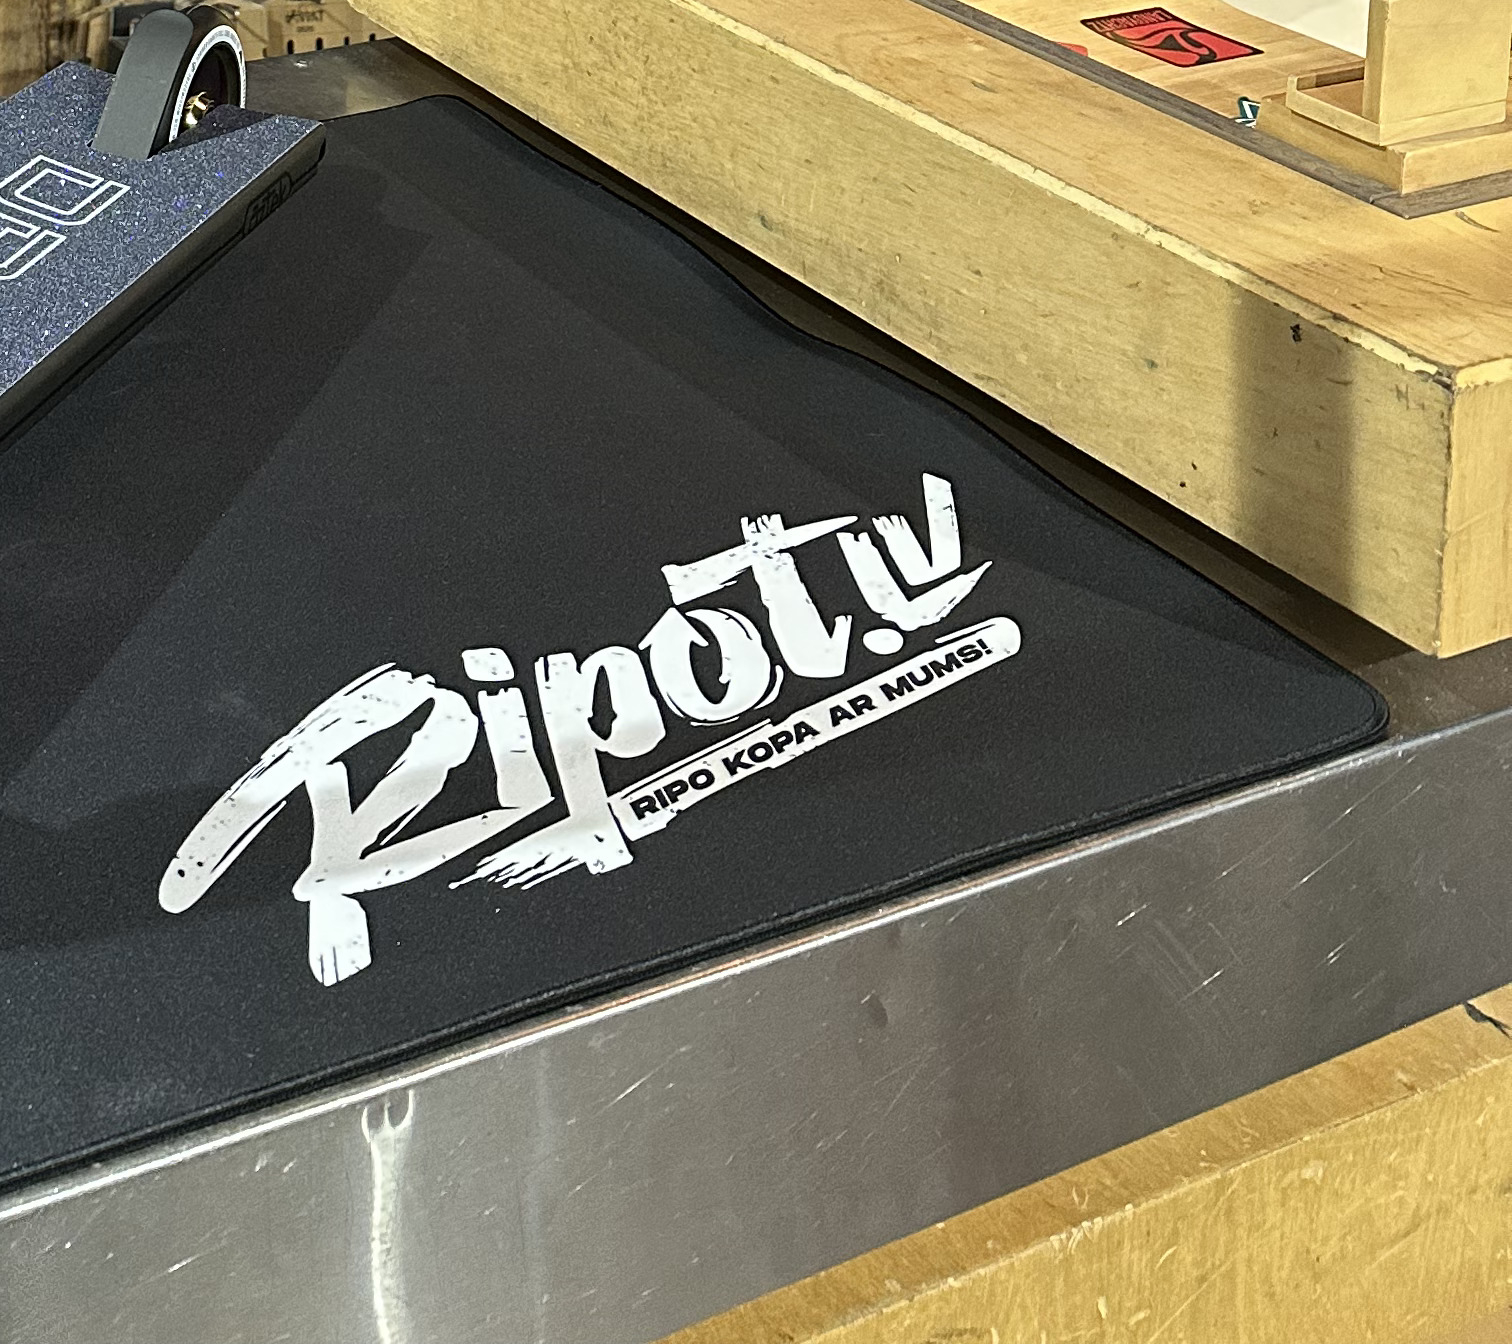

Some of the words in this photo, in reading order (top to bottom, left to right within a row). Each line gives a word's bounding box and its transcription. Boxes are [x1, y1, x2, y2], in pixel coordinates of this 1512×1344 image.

[628, 768, 718, 822] RIPO
[718, 720, 817, 780] KOPA
[829, 692, 878, 729] AR
[882, 637, 994, 702] MUMS!
